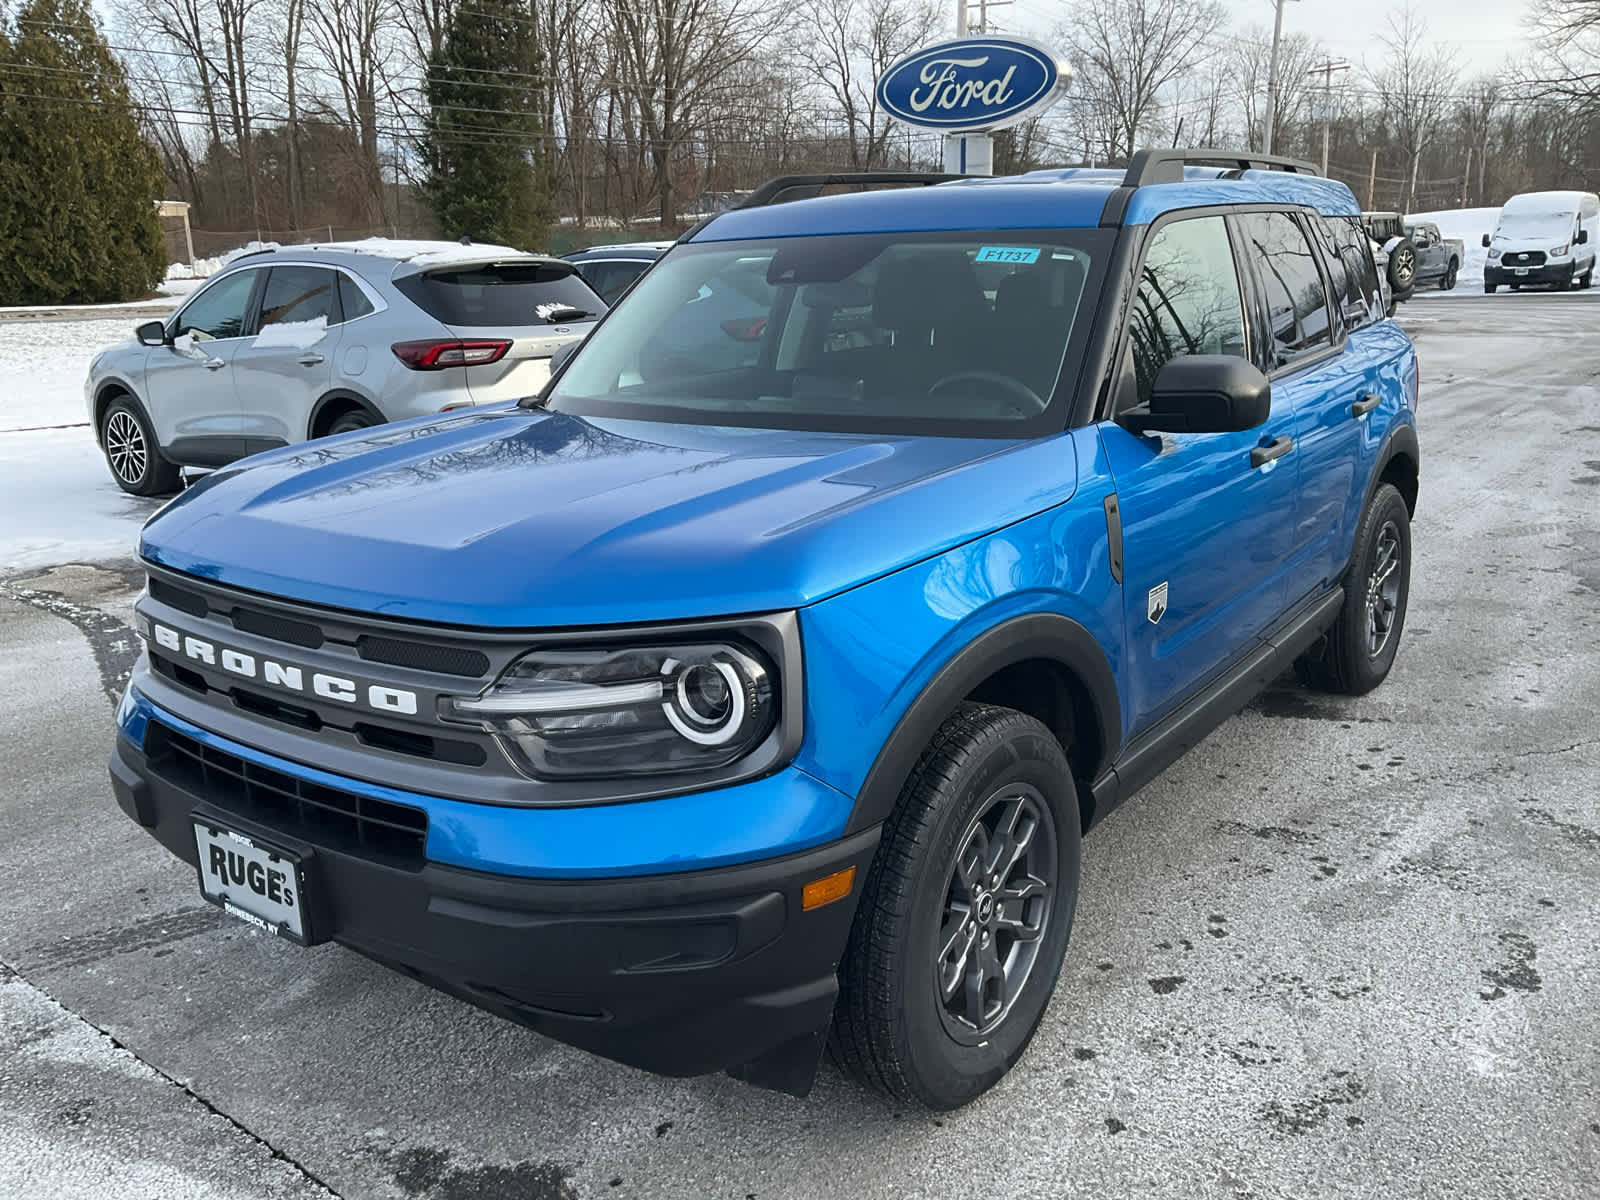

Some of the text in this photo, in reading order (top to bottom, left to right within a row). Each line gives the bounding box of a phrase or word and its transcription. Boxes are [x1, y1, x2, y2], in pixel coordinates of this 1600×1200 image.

[910, 56, 1017, 112] Ford
[984, 250, 1032, 262] F1737
[154, 624, 417, 715] BRONCO
